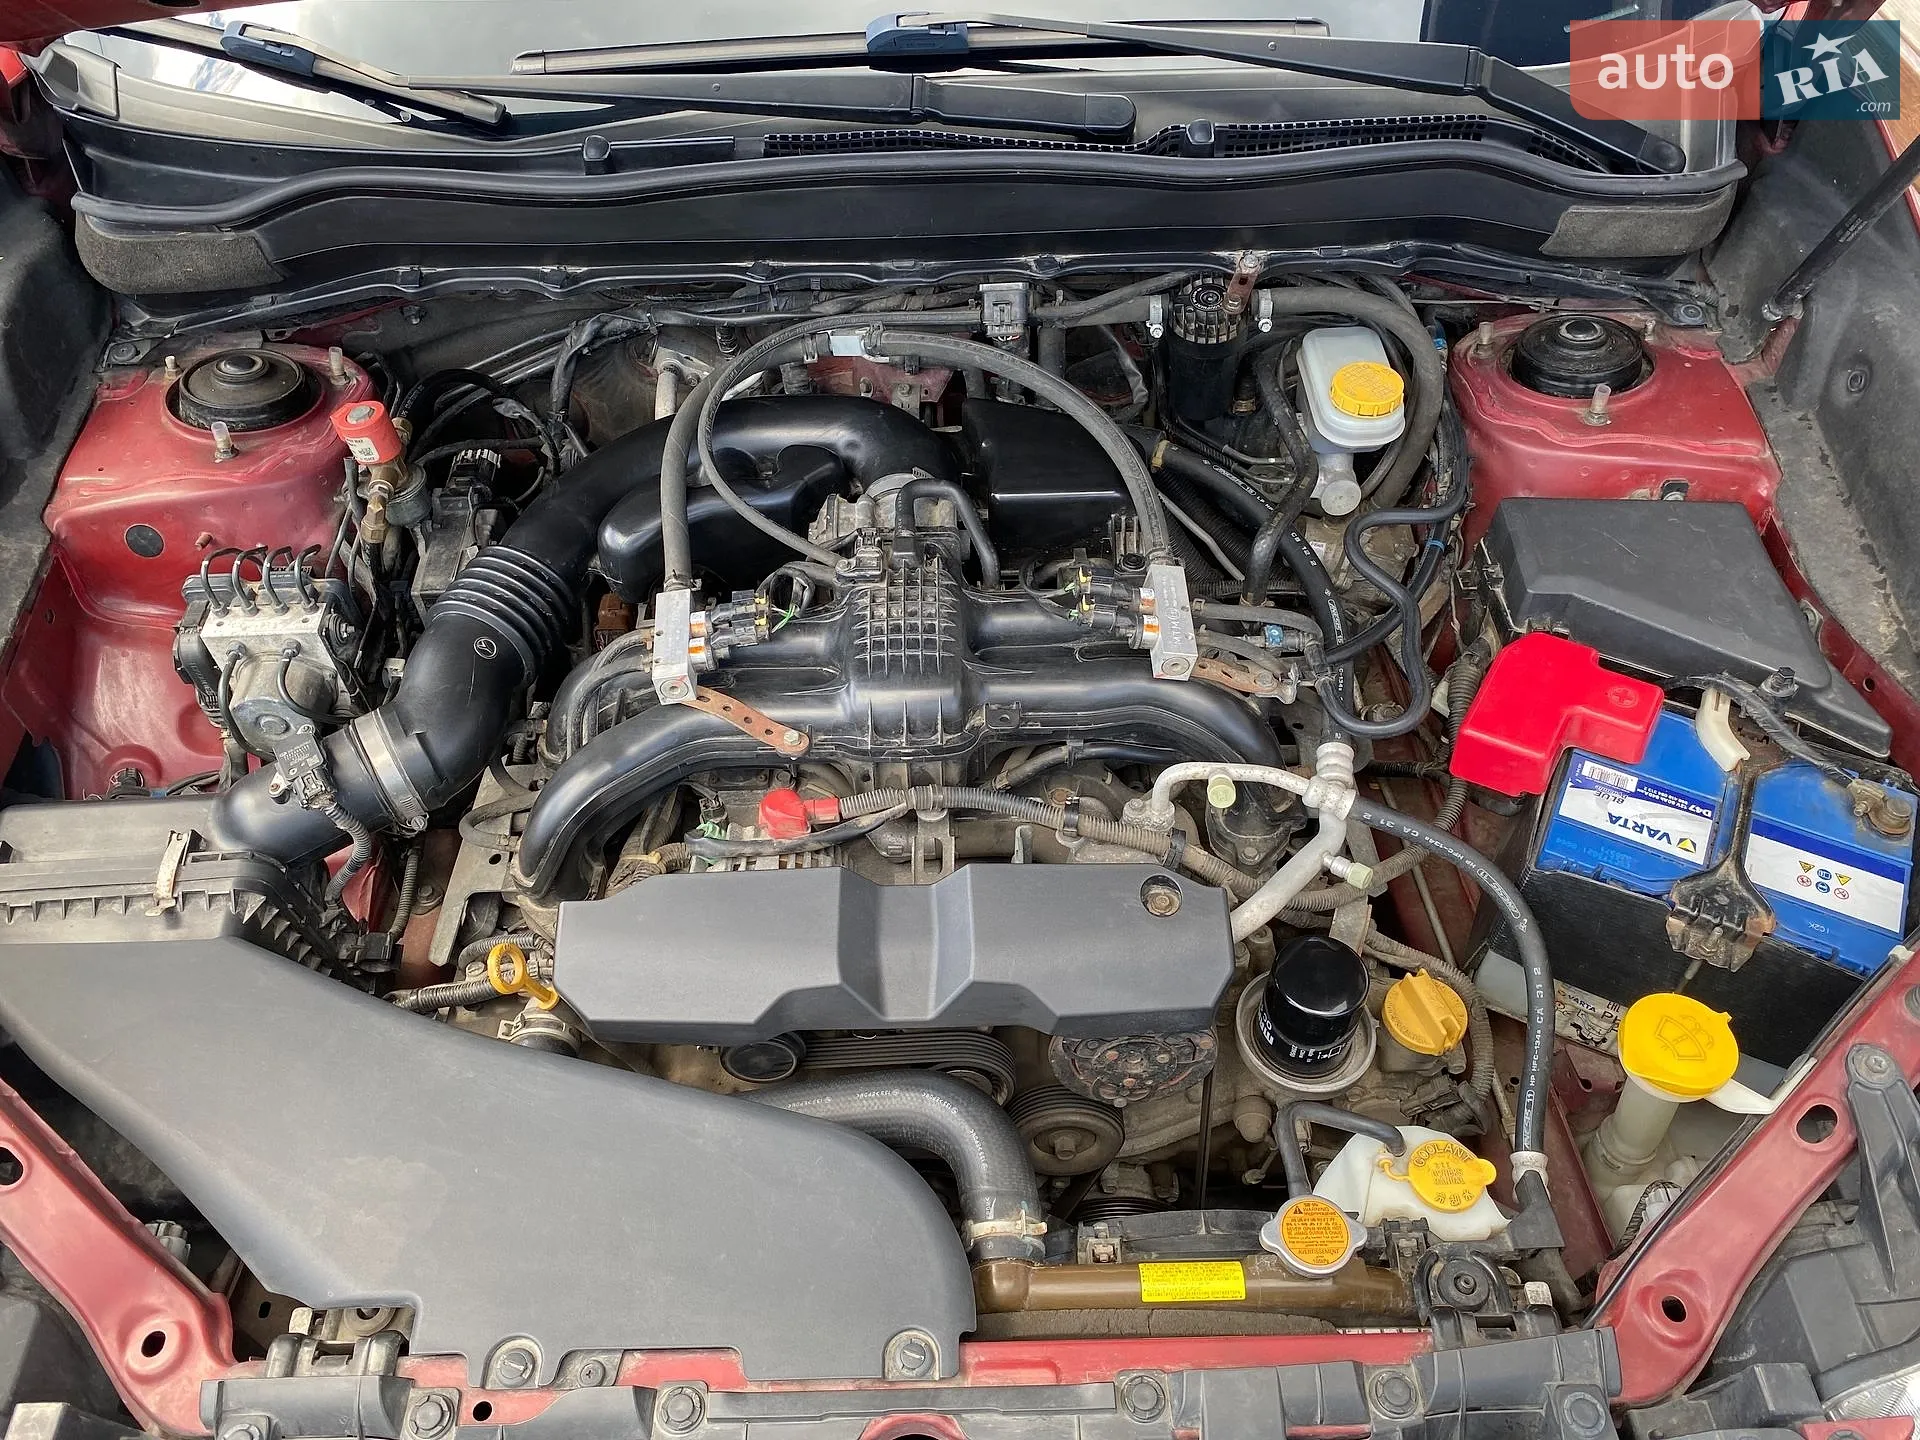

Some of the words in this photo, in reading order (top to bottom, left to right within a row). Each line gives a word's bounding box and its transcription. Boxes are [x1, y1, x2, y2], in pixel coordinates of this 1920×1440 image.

[1593, 790, 1625, 805] BLUE
[1362, 812, 1372, 820] 2
[1380, 818, 1395, 828] 31
[1402, 825, 1420, 838] CA
[1605, 812, 1672, 845] VARTA
[1534, 967, 1541, 976] 2
[1536, 984, 1544, 998] 31
[1568, 994, 1597, 1013] VARTA
[1537, 1008, 1544, 1024] CA
[1530, 1074, 1536, 1087] HP
[1413, 1142, 1474, 1167] COOLANT
